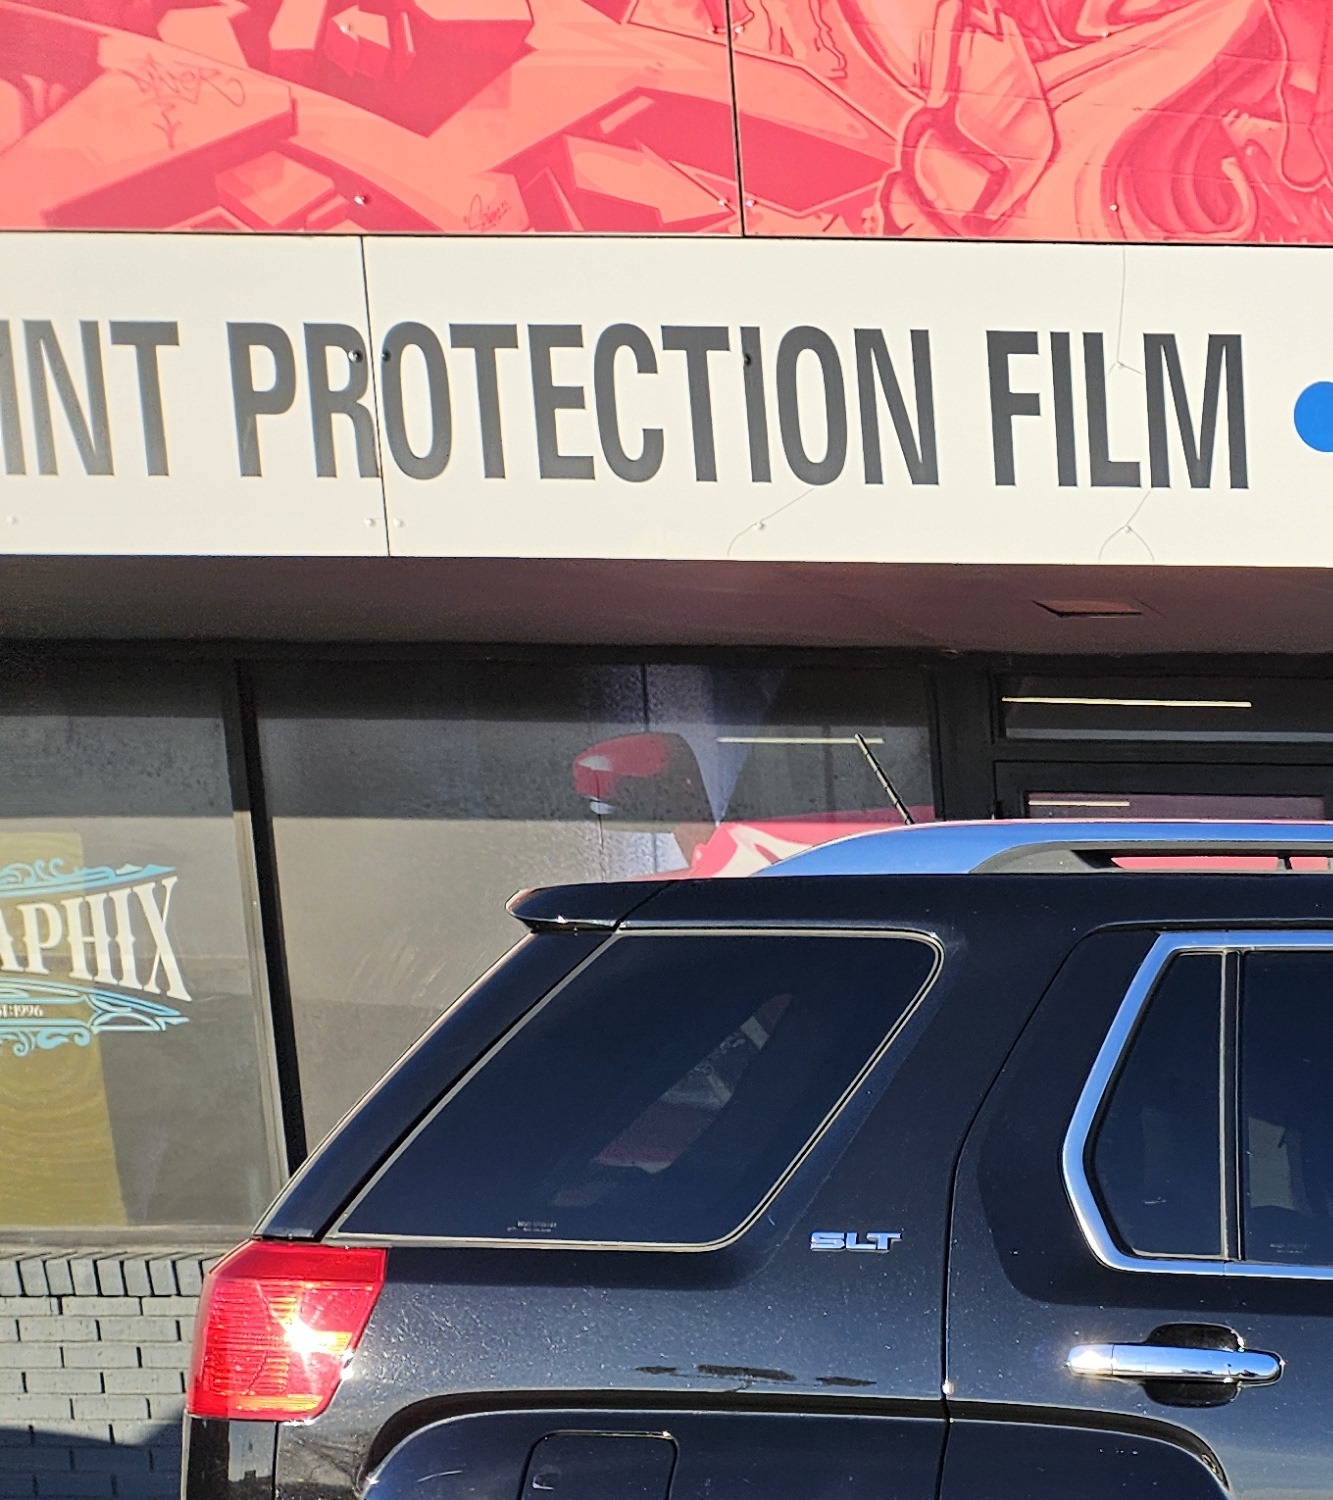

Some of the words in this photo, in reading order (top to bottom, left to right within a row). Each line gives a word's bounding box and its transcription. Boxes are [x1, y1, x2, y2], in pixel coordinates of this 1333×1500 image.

[226, 320, 940, 487] PROTECTION
[985, 329, 1250, 490] FILM
[810, 1231, 902, 1253] SLT
